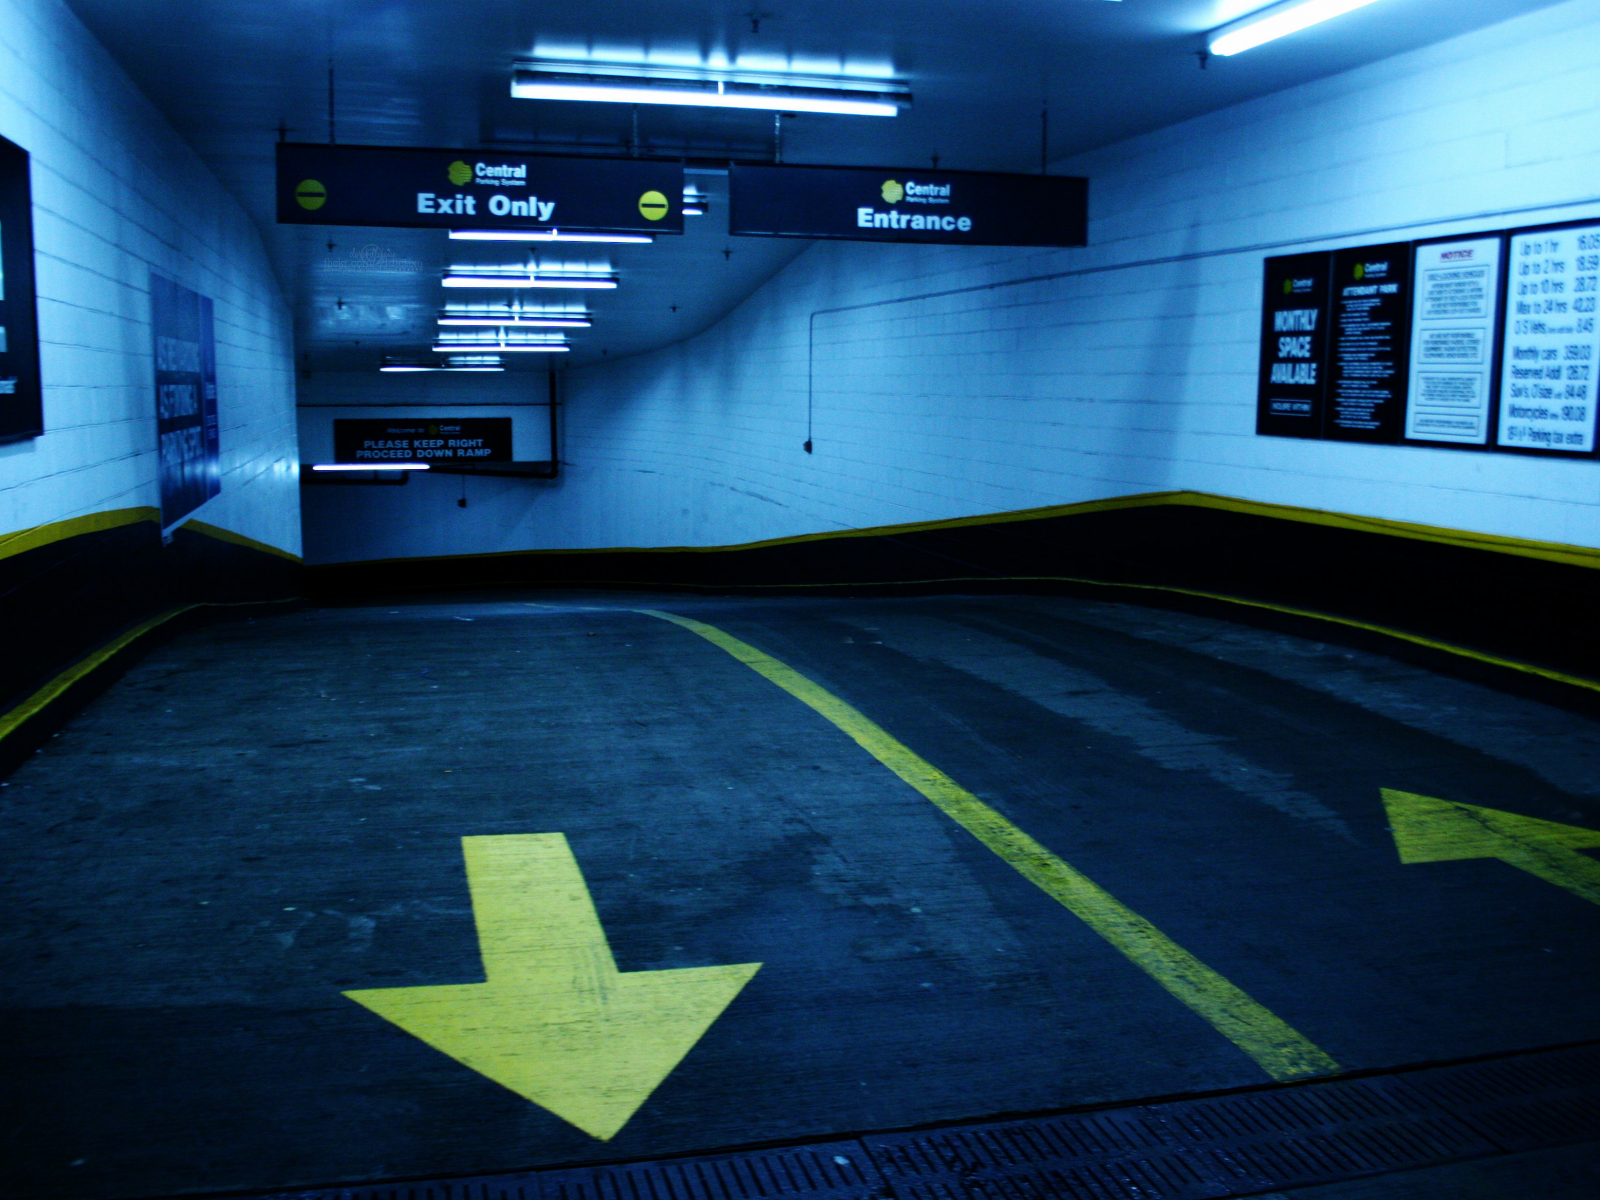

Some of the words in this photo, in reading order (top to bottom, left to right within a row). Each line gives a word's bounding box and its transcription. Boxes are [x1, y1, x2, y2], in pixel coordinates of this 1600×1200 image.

[475, 162, 527, 179] Central
[501, 178, 527, 187] System
[905, 181, 951, 197] Central
[416, 192, 476, 216] Exit
[488, 194, 555, 221] Only
[857, 207, 972, 232] Entrance
[1440, 250, 1474, 261] NOTICE
[1520, 241, 1531, 256] Up
[1533, 242, 1542, 255] to
[1550, 238, 1559, 253] hr
[1518, 261, 1530, 277] Up
[1532, 261, 1541, 275] to
[1543, 258, 1549, 274] 2
[1551, 258, 1565, 273] hrs
[1575, 254, 1599, 272] 18.59
[1342, 285, 1378, 297] ATTENDANT
[1379, 284, 1399, 294] PARK
[1517, 281, 1528, 297] Up
[1530, 281, 1538, 295] to
[1540, 278, 1549, 294] 10
[1551, 278, 1564, 294] hrs
[1574, 276, 1597, 292] 28.72
[1516, 300, 1531, 315] Max
[1533, 301, 1542, 314] to
[1543, 299, 1553, 314] 24
[1555, 299, 1568, 314] hrs
[1572, 296, 1596, 312] 42.23
[1274, 309, 1318, 332] MONTHLY
[1278, 336, 1312, 358] SPACE
[1512, 345, 1539, 363] Monthly
[1541, 348, 1558, 360] cars
[1270, 363, 1317, 386] AVAILABLE
[1511, 364, 1544, 380] Reserved
[1564, 384, 1587, 400] 84.48
[1508, 404, 1548, 422] Motorcycles
[364, 440, 410, 449] PLEASE
[414, 439, 445, 448] KEEP
[448, 438, 484, 448] RIGHT
[1553, 430, 1564, 444] tax
[356, 450, 412, 459] PROCEED
[416, 449, 454, 458] DOWN
[457, 448, 492, 458] RAMP
